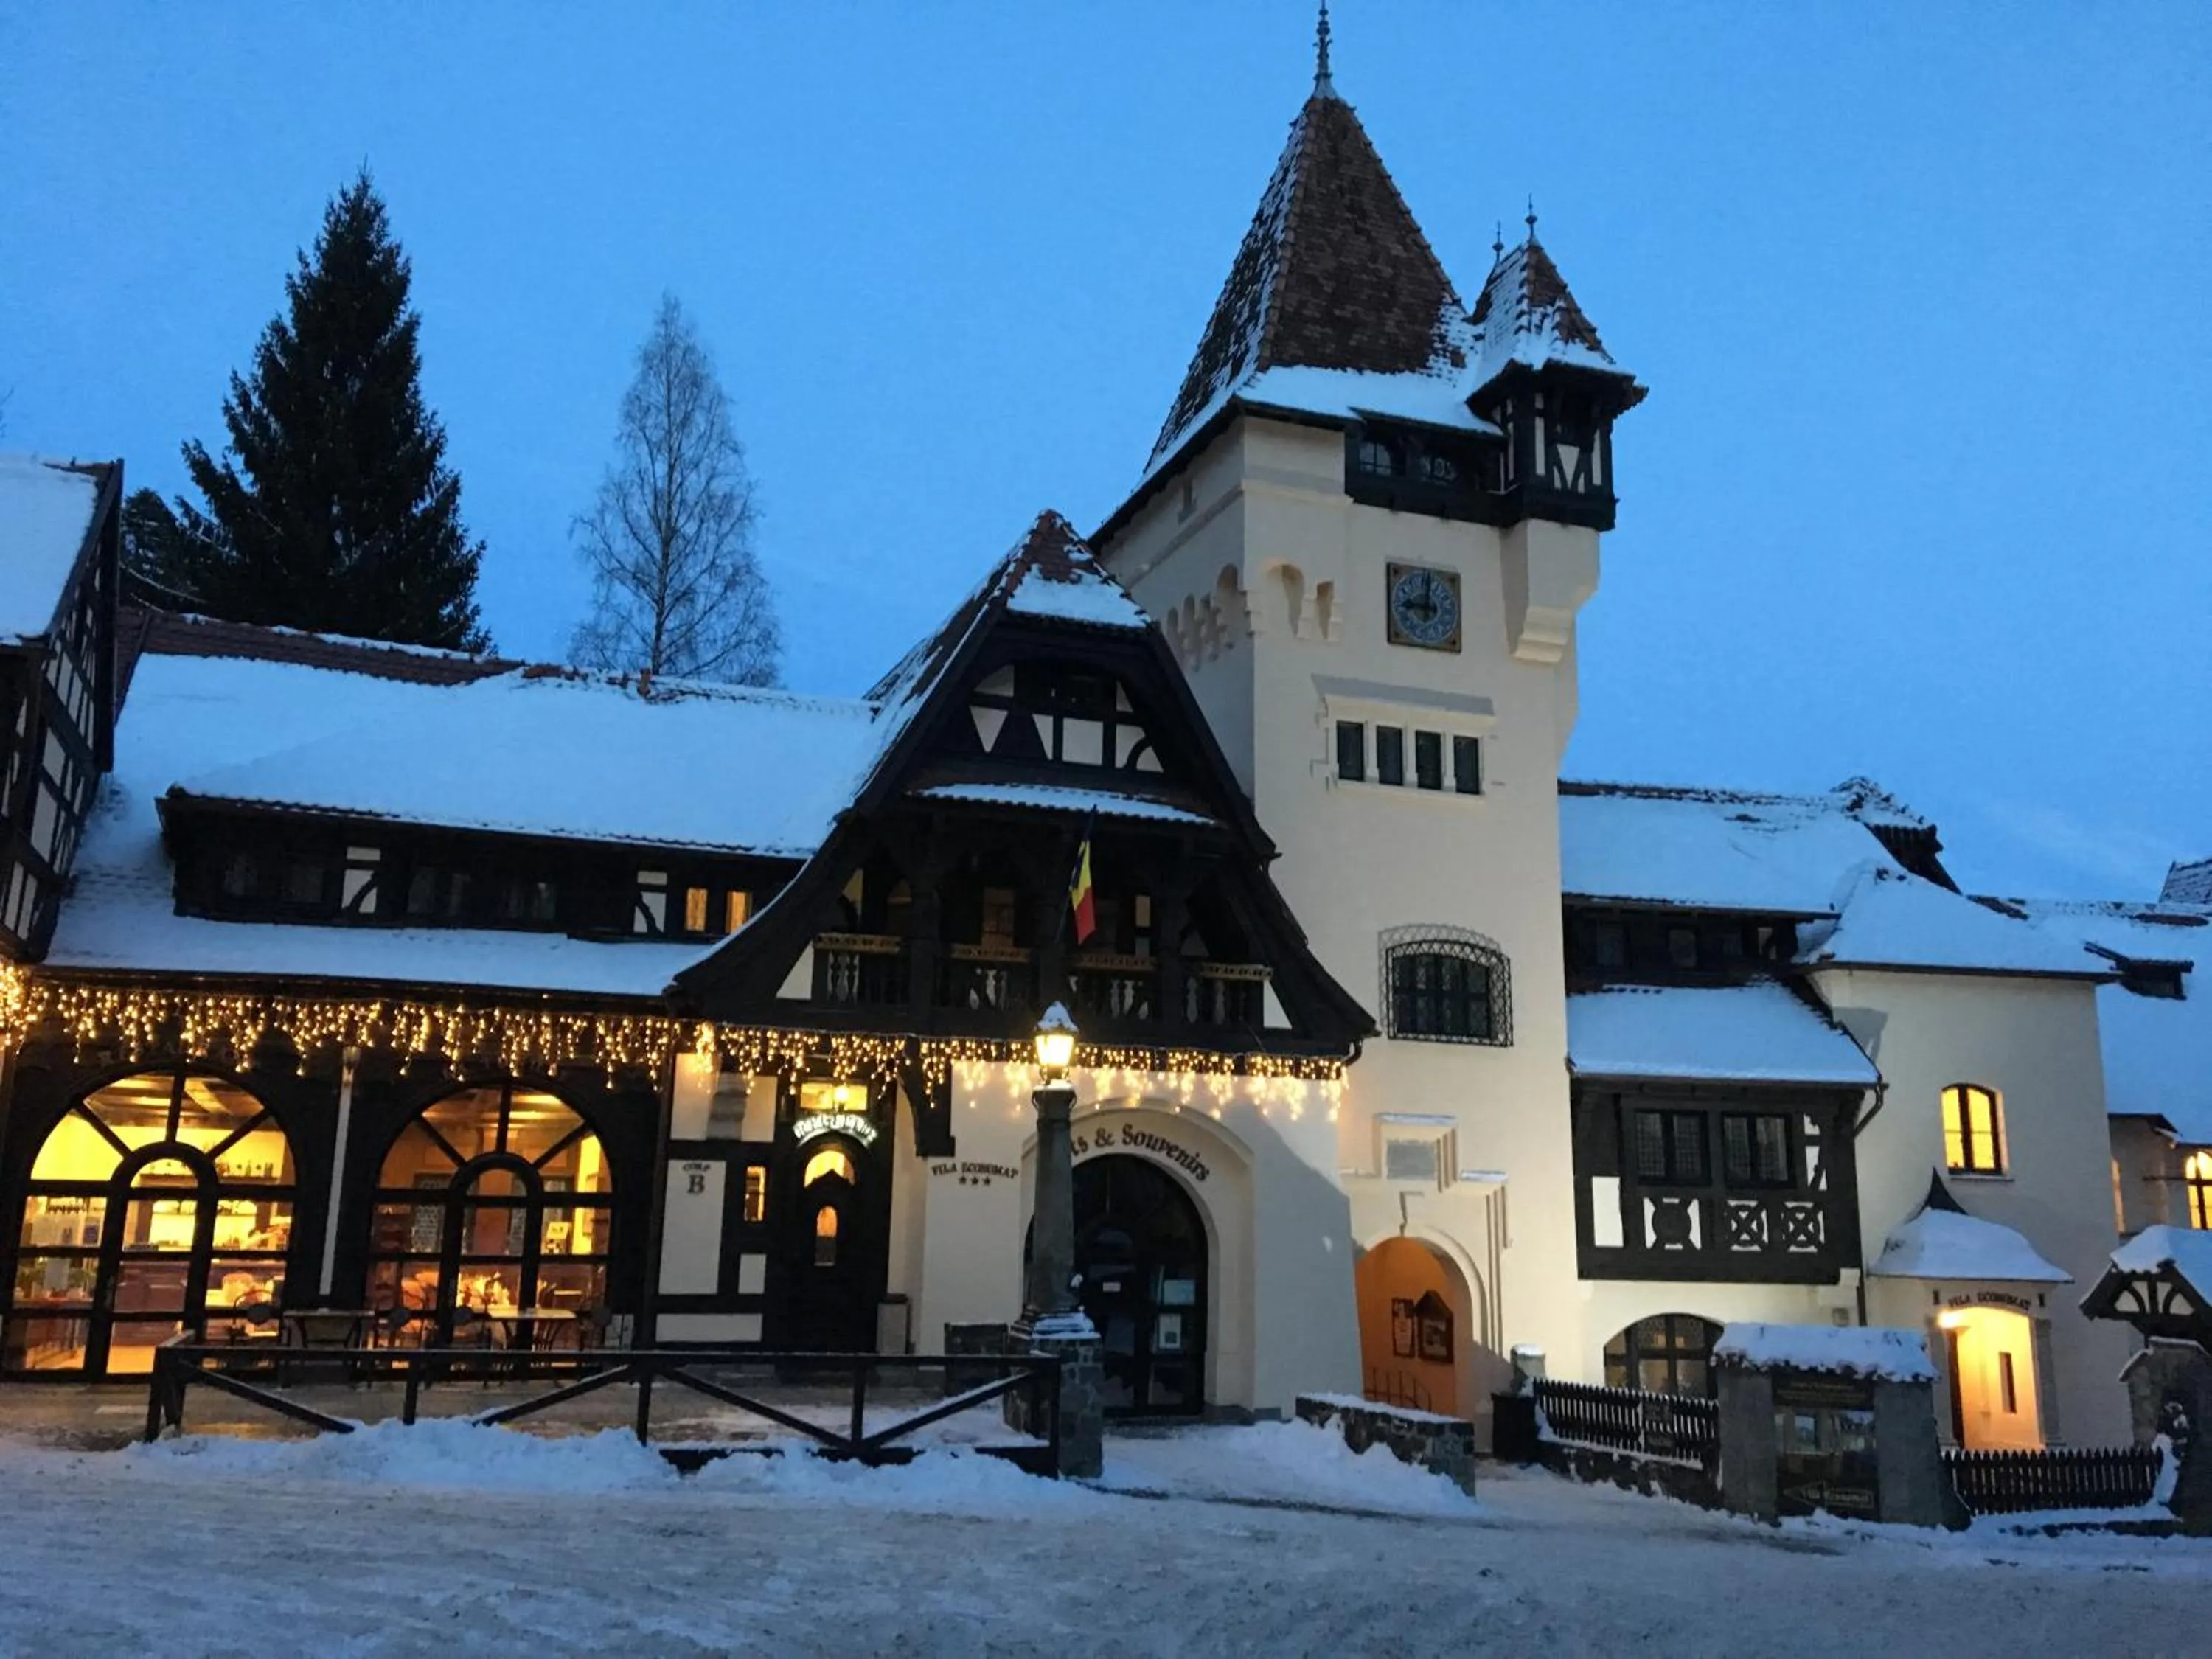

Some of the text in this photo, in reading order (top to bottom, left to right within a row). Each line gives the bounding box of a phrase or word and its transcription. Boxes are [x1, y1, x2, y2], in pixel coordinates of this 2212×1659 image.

[1094, 1127, 1115, 1148] &
[1121, 1123, 1210, 1182] Souvenirs
[686, 1174, 705, 1194] B
